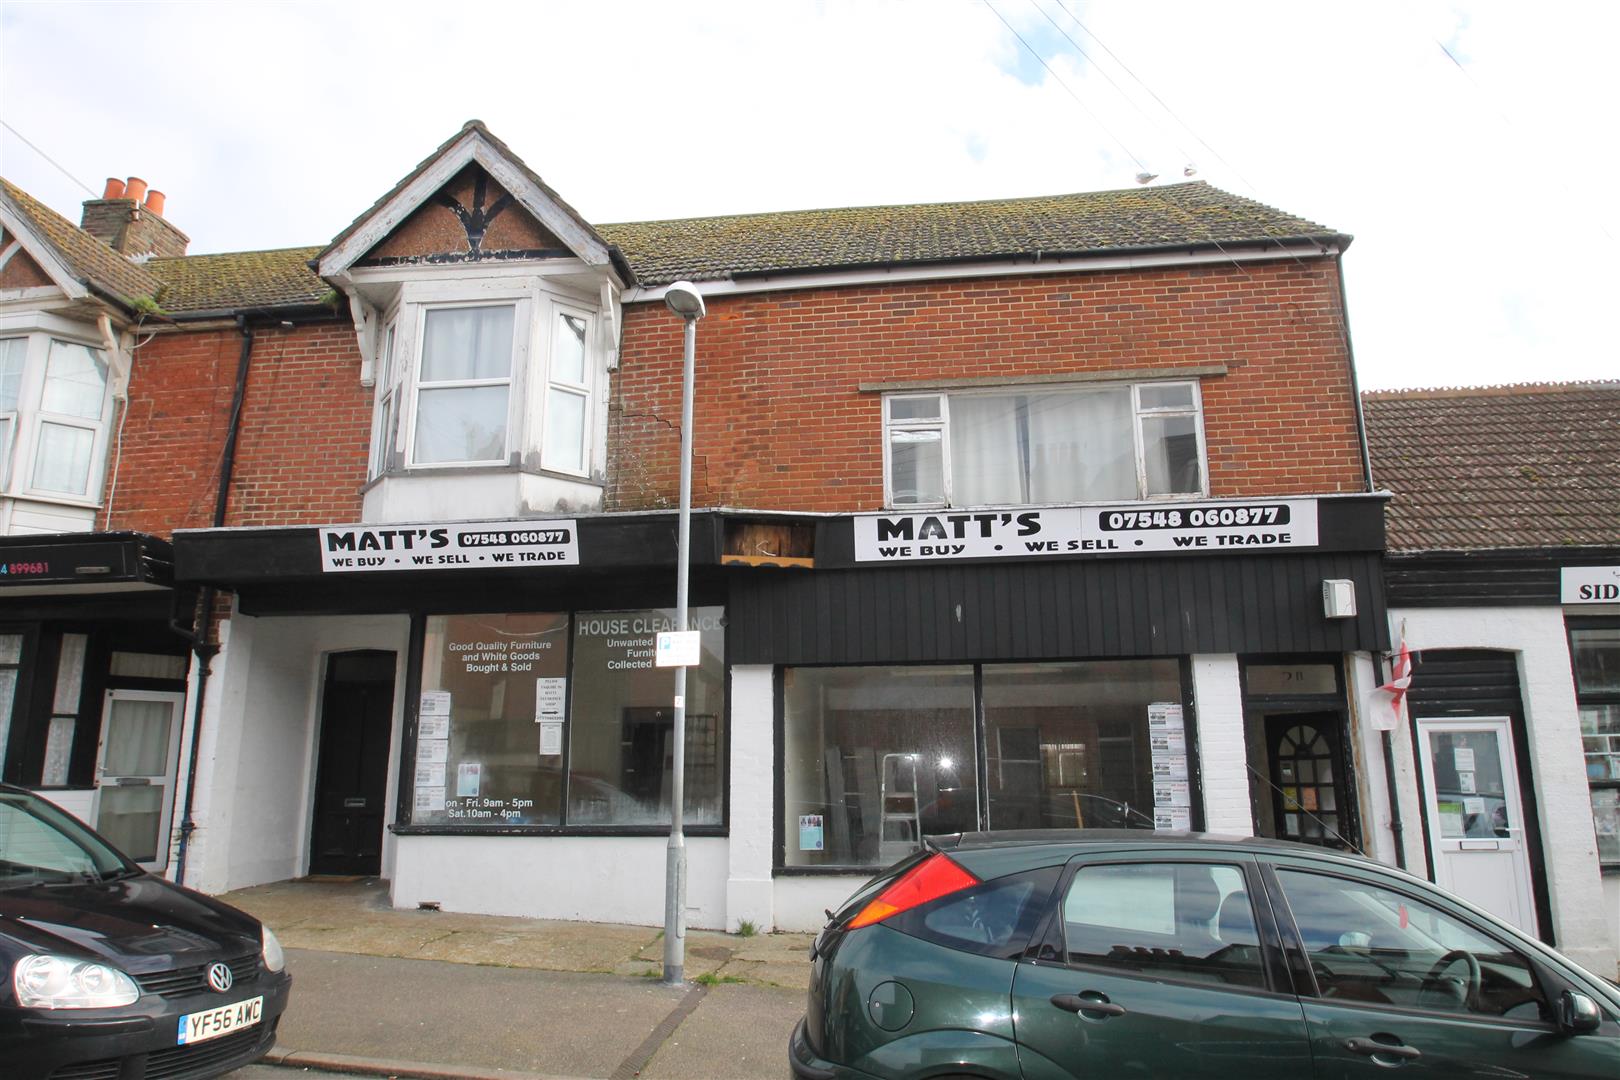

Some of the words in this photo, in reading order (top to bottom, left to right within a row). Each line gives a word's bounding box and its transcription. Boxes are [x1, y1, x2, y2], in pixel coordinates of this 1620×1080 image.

[1109, 511, 1181, 529] 07548
[1189, 507, 1280, 527] 060877
[877, 513, 1041, 541] MATT'S
[327, 528, 449, 551] MATT'S
[463, 534, 507, 545] 07548
[511, 531, 564, 544] 060877
[879, 547, 912, 557] WE
[919, 545, 965, 556] BUY
[1025, 541, 1059, 552] WE
[1067, 539, 1119, 551] SELL
[1173, 535, 1208, 547] WE
[1215, 533, 1292, 545] TRADE
[332, 558, 353, 567] WE
[357, 556, 386, 566] BUY
[412, 556, 434, 565] WE
[438, 554, 470, 564] SELL
[492, 553, 514, 562] WE
[518, 551, 566, 562] TRADE
[0, 564, 7, 574] 4
[9, 562, 49, 574] 899681
[578, 620, 629, 635] HOUSE
[449, 642, 473, 651] Good
[476, 641, 508, 652] Quality
[510, 641, 552, 650] Furniture
[607, 638, 653, 647] Unwanted
[462, 653, 479, 661] and
[481, 652, 508, 661] White
[510, 651, 540, 661] Goods
[627, 649, 657, 658] Furnit
[466, 663, 499, 673] Bought
[502, 663, 508, 672] &
[510, 663, 531, 672] Sold
[607, 660, 653, 669] Collected
[466, 798, 481, 807] Fri.
[483, 798, 503, 807] 9am
[512, 798, 533, 809] 5pm
[500, 809, 521, 820] 4pm
[192, 1010, 232, 1037] YF56
[236, 1001, 260, 1025] AWC
